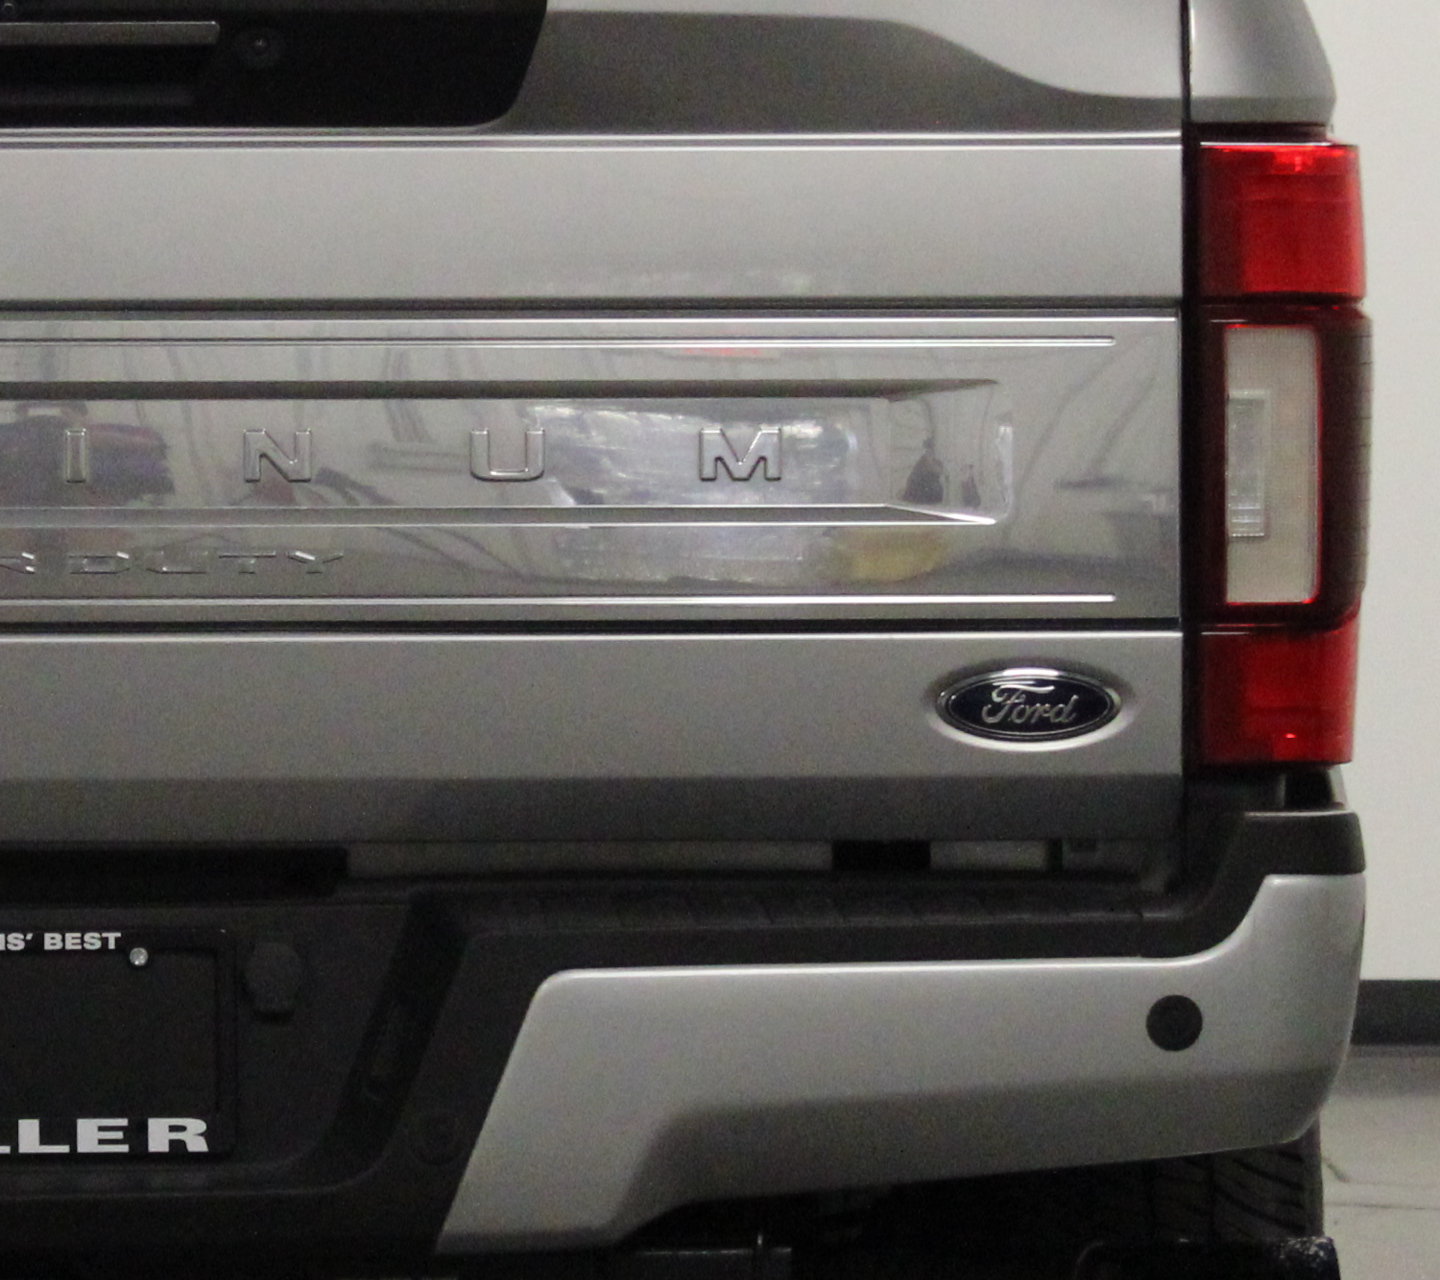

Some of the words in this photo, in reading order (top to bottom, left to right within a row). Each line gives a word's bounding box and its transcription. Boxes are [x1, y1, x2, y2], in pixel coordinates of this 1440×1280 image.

[67, 549, 346, 576] DUTY
[981, 682, 1080, 724] Ford
[43, 932, 122, 951] BEST
